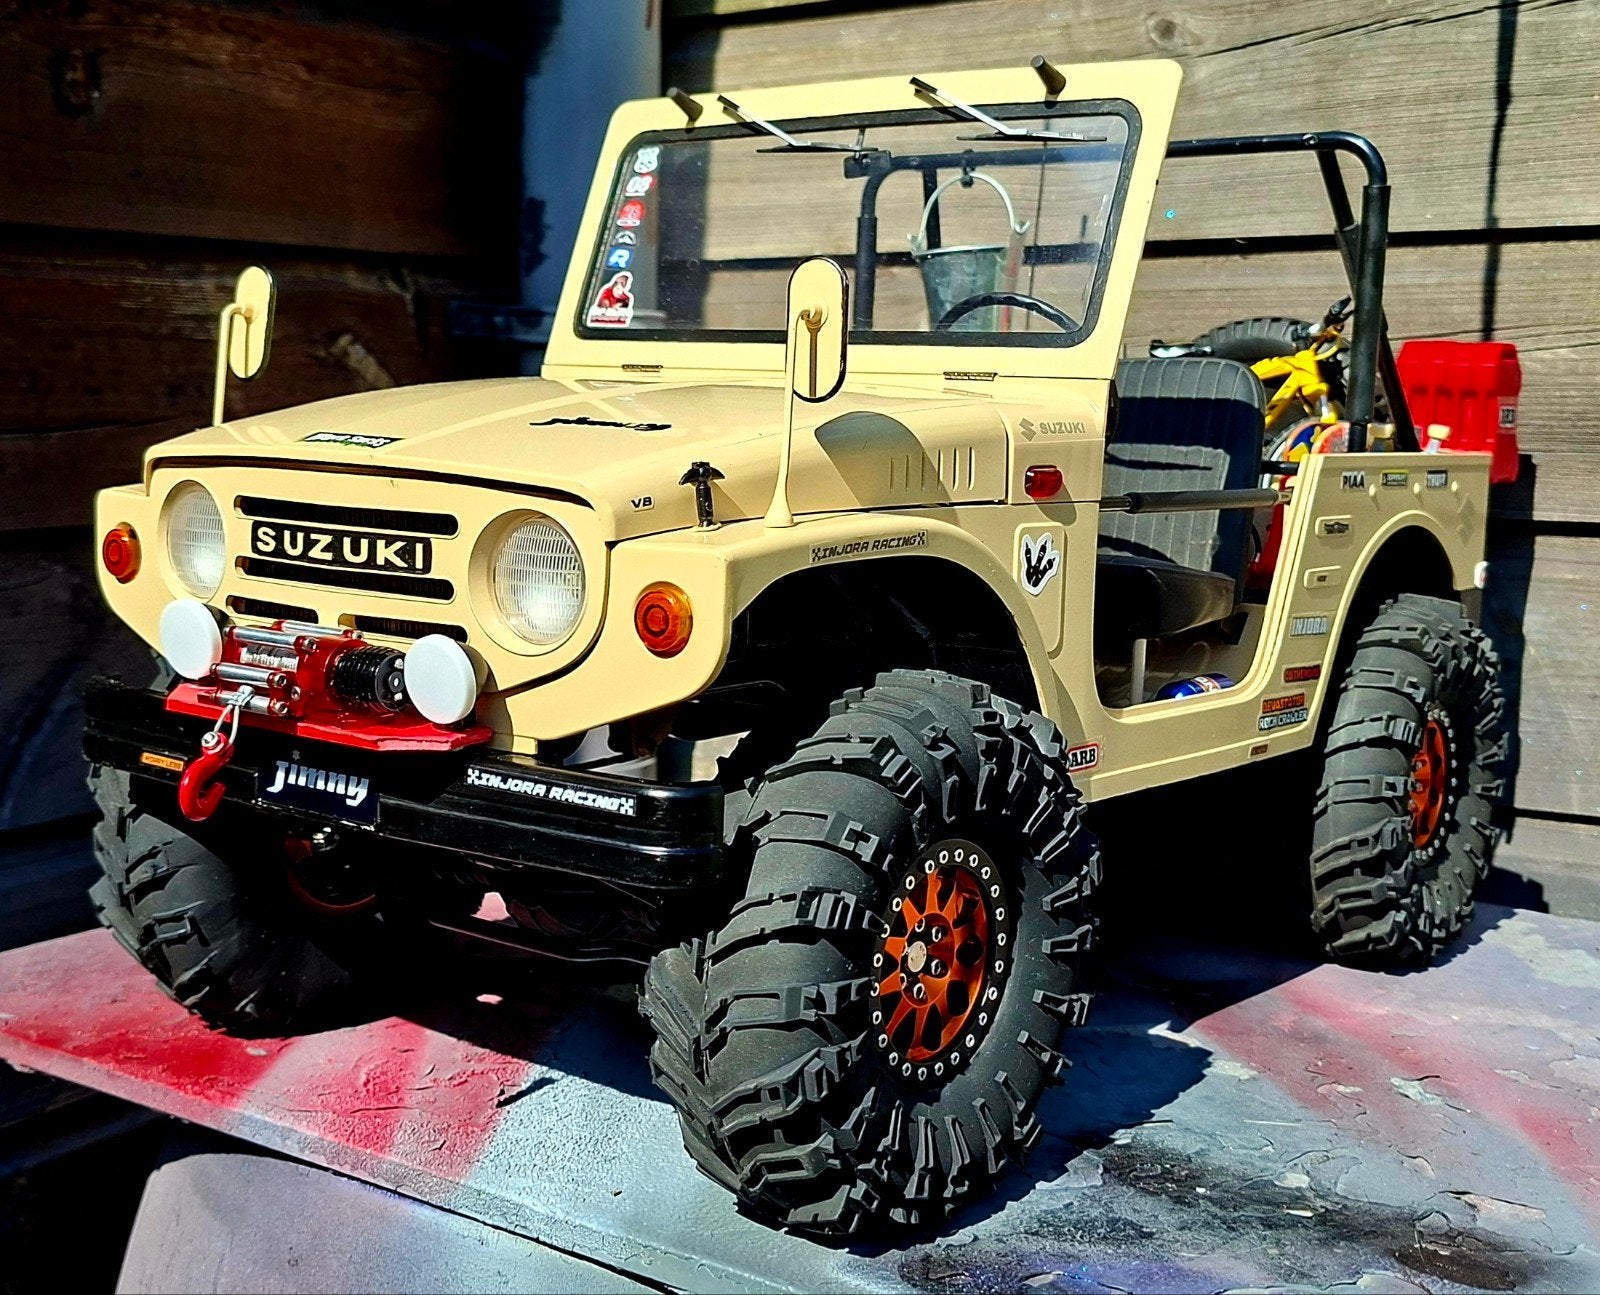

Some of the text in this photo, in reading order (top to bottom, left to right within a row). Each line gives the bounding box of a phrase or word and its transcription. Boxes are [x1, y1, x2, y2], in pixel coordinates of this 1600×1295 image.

[1039, 421, 1086, 435] SUZUKI
[256, 526, 424, 570] SUZUKI
[820, 534, 917, 560] INJORA RACING
[1290, 615, 1328, 637] INJORA
[1070, 747, 1096, 768] ARB
[266, 760, 370, 807] Jimny
[479, 771, 621, 812] INJORA RACING
